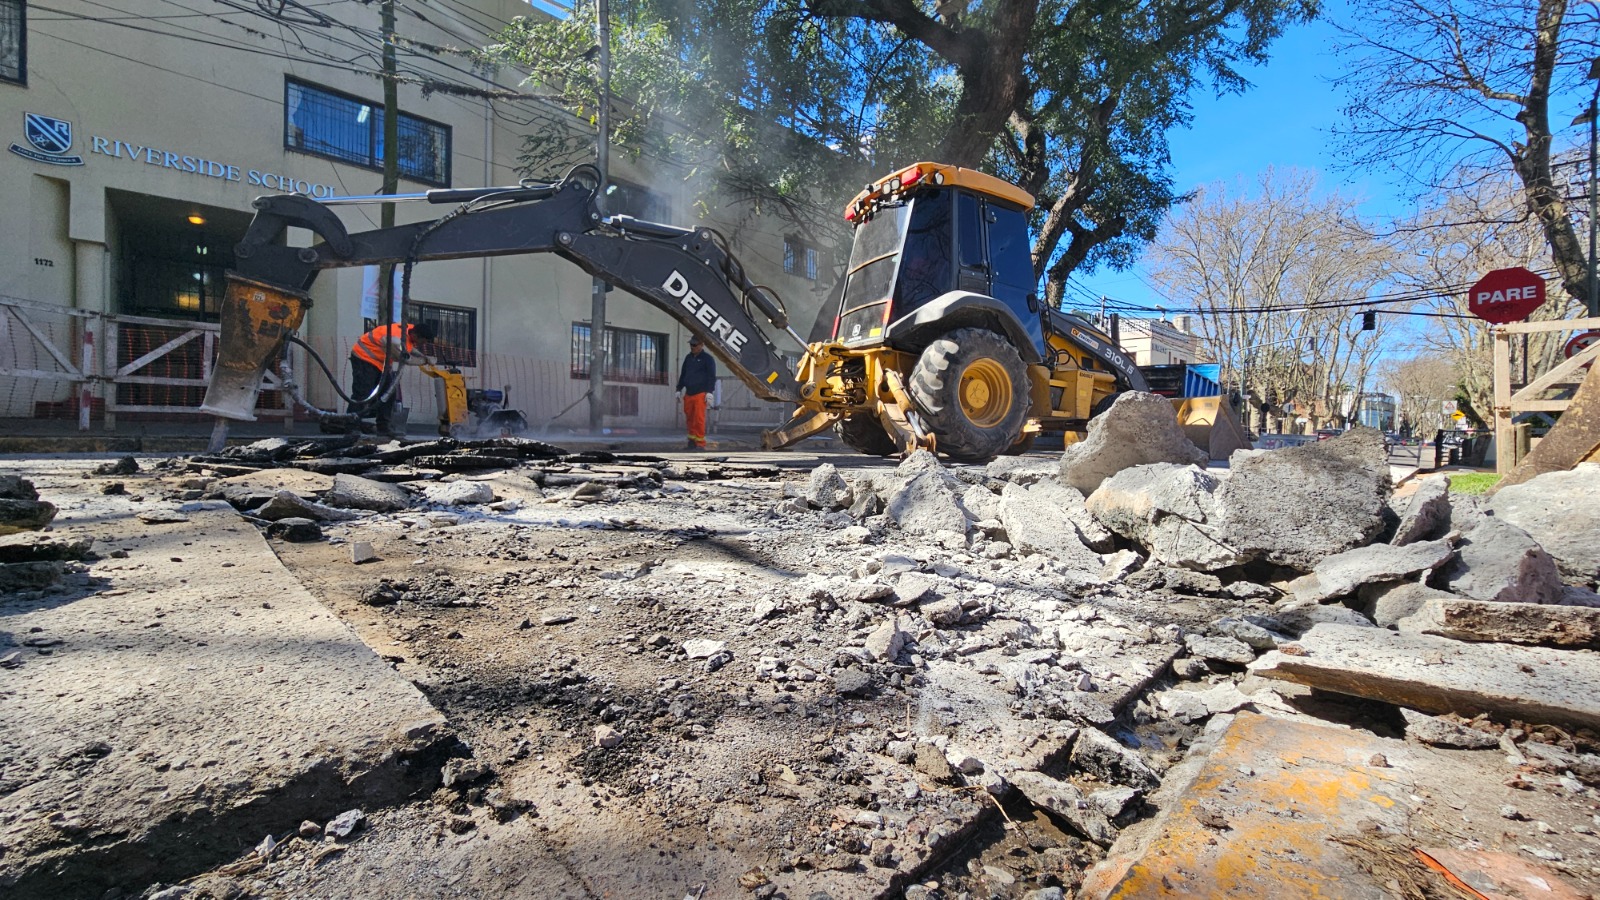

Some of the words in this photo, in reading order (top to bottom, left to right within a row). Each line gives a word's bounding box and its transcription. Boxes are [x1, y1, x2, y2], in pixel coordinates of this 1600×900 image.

[54, 121, 69, 136] R
[91, 135, 242, 182] RIVERSIDE
[248, 169, 337, 199] SCHOOL
[34, 257, 54, 268] 1172
[1477, 285, 1537, 305] PARE
[662, 269, 748, 353] DEERE
[1105, 348, 1125, 369] 310L
